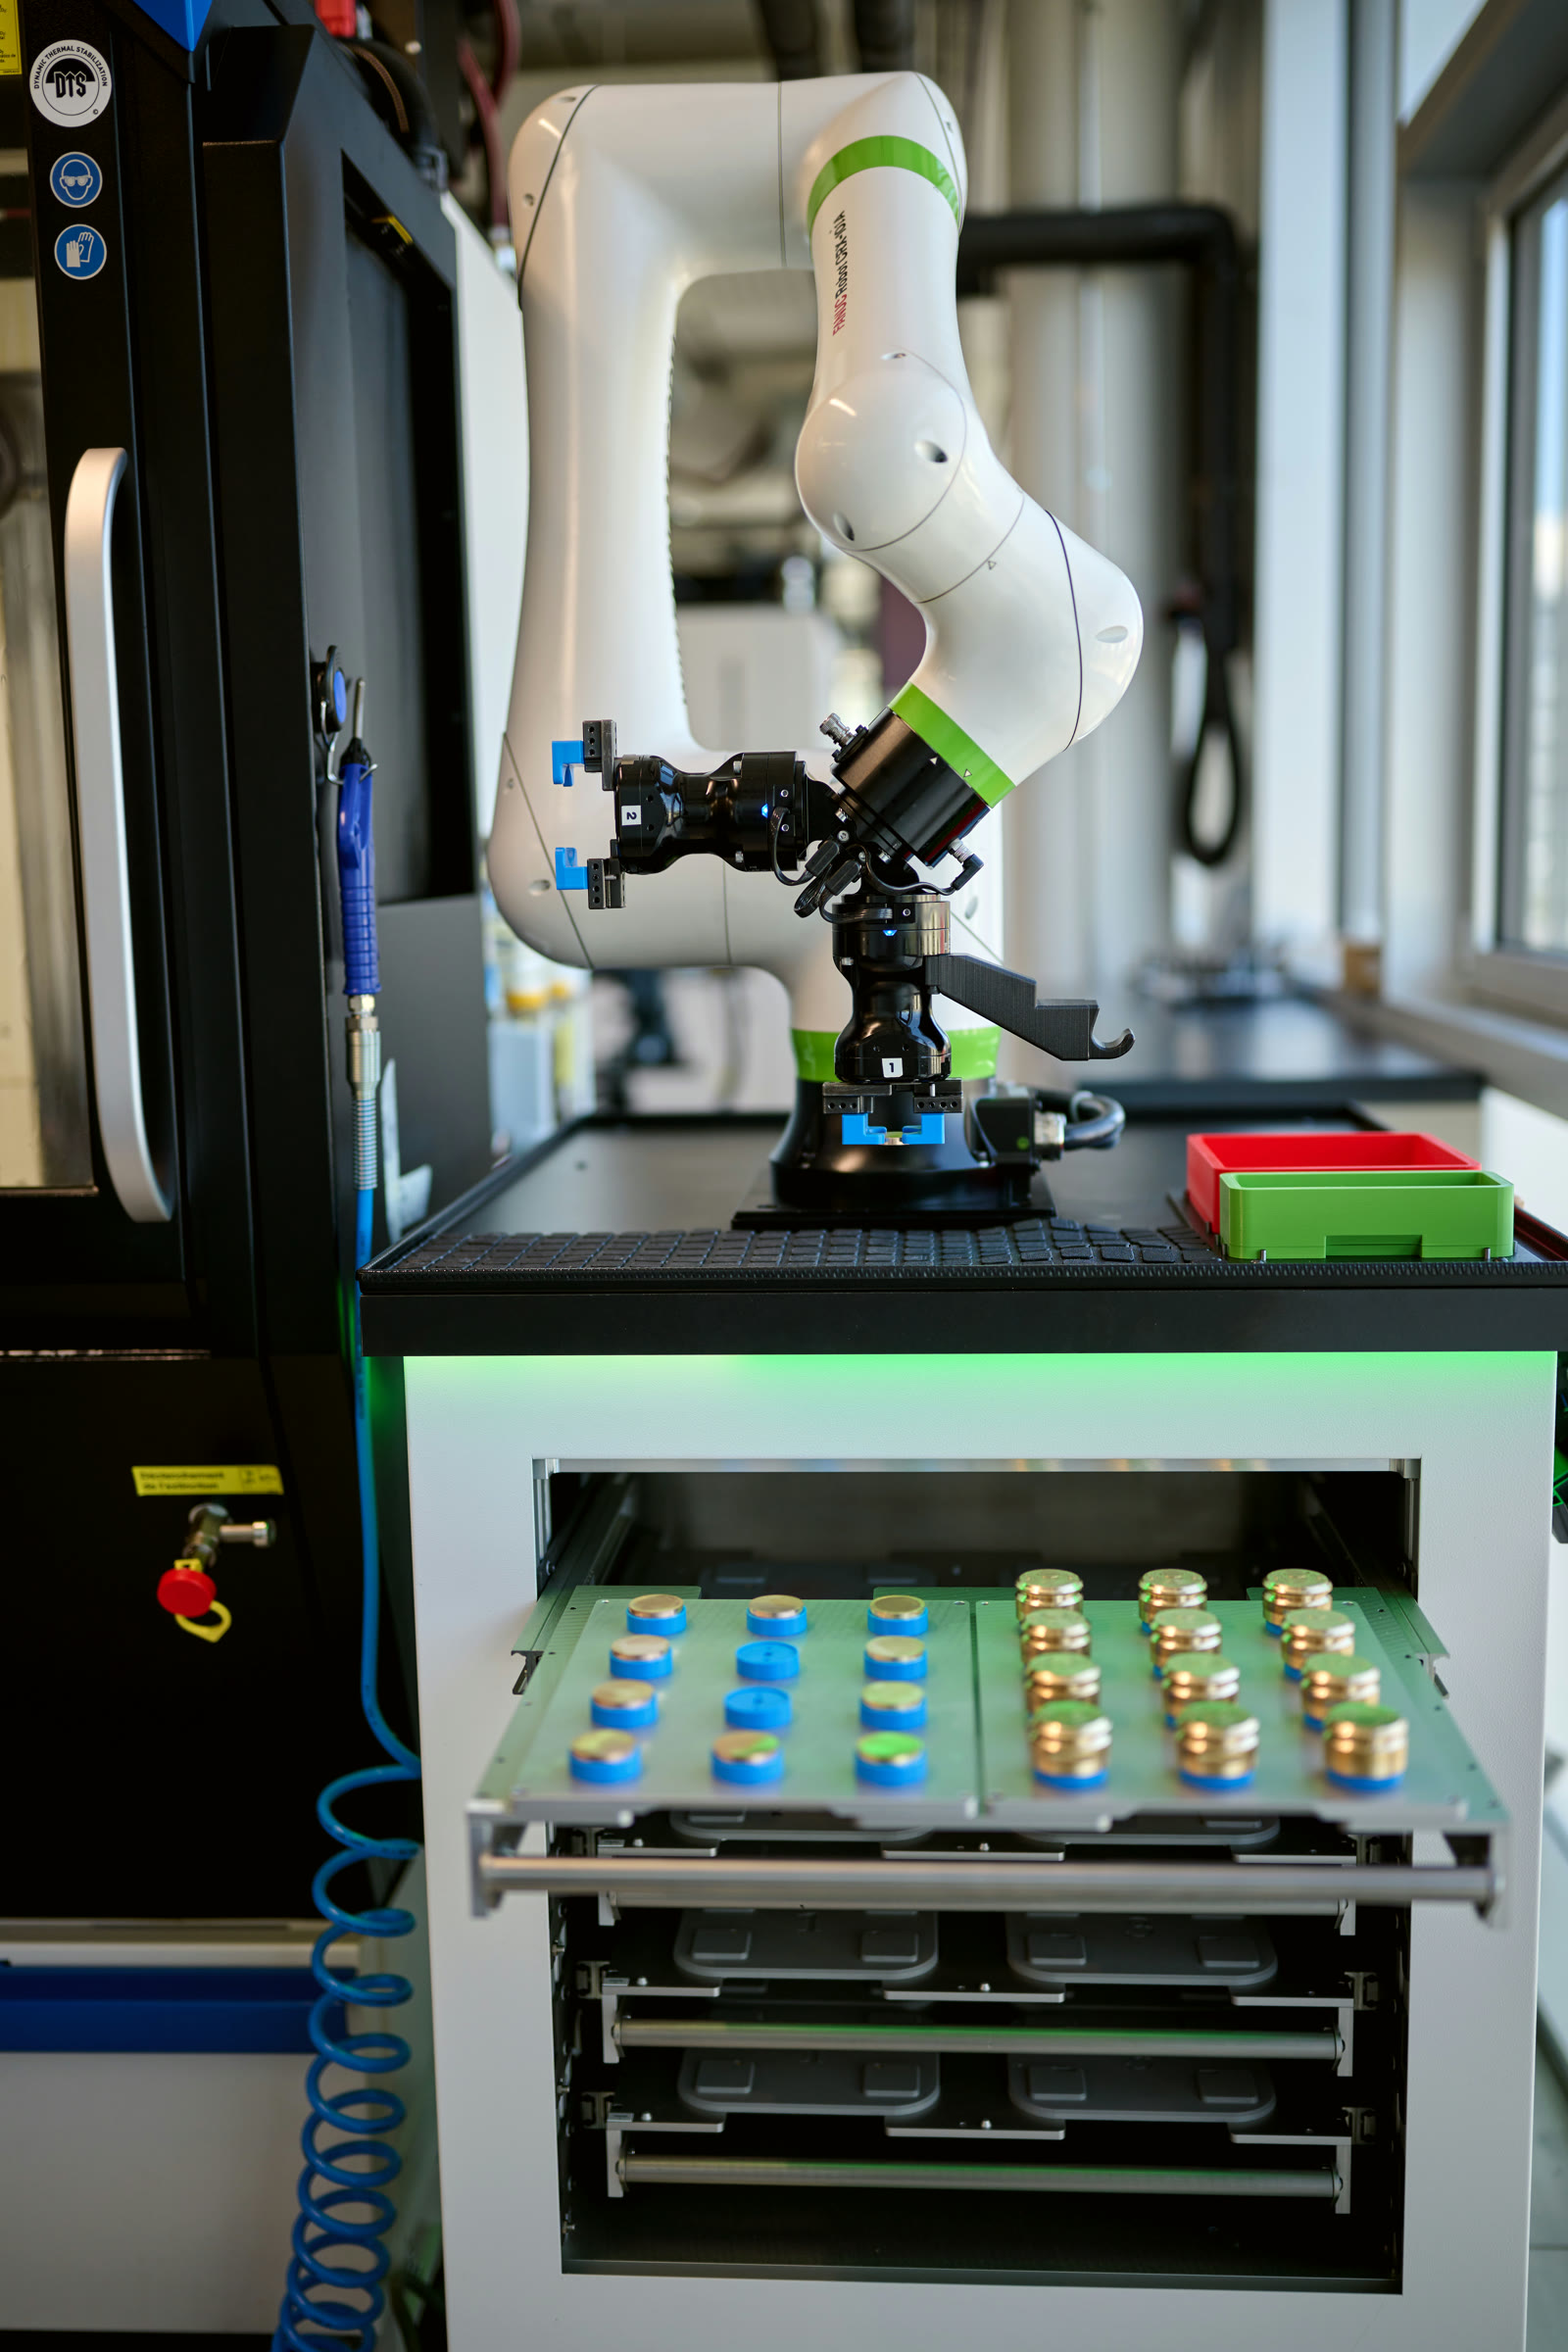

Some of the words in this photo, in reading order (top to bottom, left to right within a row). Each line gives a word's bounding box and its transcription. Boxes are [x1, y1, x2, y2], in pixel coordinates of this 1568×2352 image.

[34, 59, 47, 89] DYNAMIC
[44, 45, 75, 60] THERMAL
[76, 46, 108, 87] STABILIZATION
[54, 72, 87, 99] DTS
[835, 261, 849, 299] Robot
[832, 294, 848, 336] FANUC
[627, 811, 637, 820] 2
[889, 1061, 895, 1073] 1
